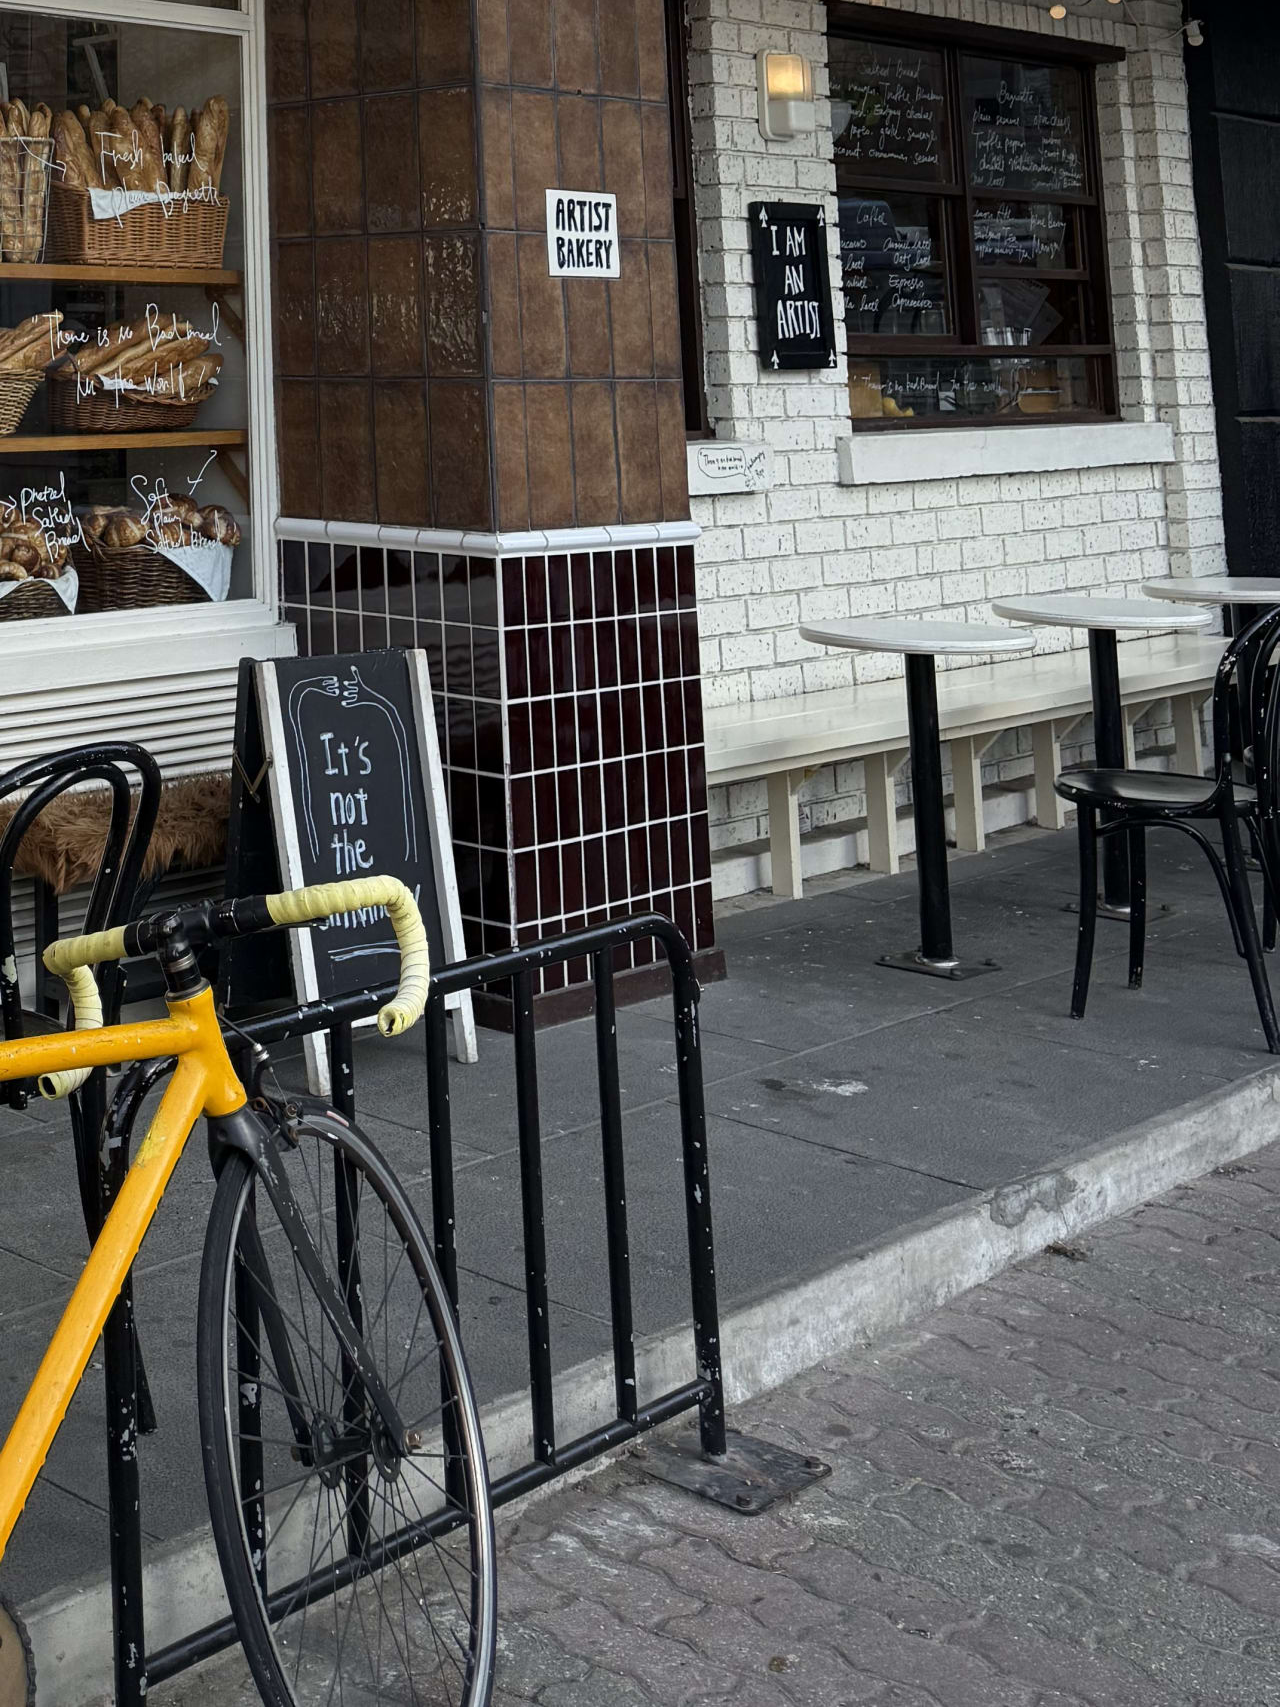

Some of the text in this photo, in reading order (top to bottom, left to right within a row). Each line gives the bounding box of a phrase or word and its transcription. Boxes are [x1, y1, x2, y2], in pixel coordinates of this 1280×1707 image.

[556, 198, 613, 233] ARTIST
[556, 237, 614, 269] BAKERY
[770, 225, 806, 257] I AM
[784, 264, 805, 295] AN
[777, 300, 822, 340] ARTIST
[320, 731, 372, 777] It's
[329, 787, 369, 826] not
[330, 828, 374, 876] the
